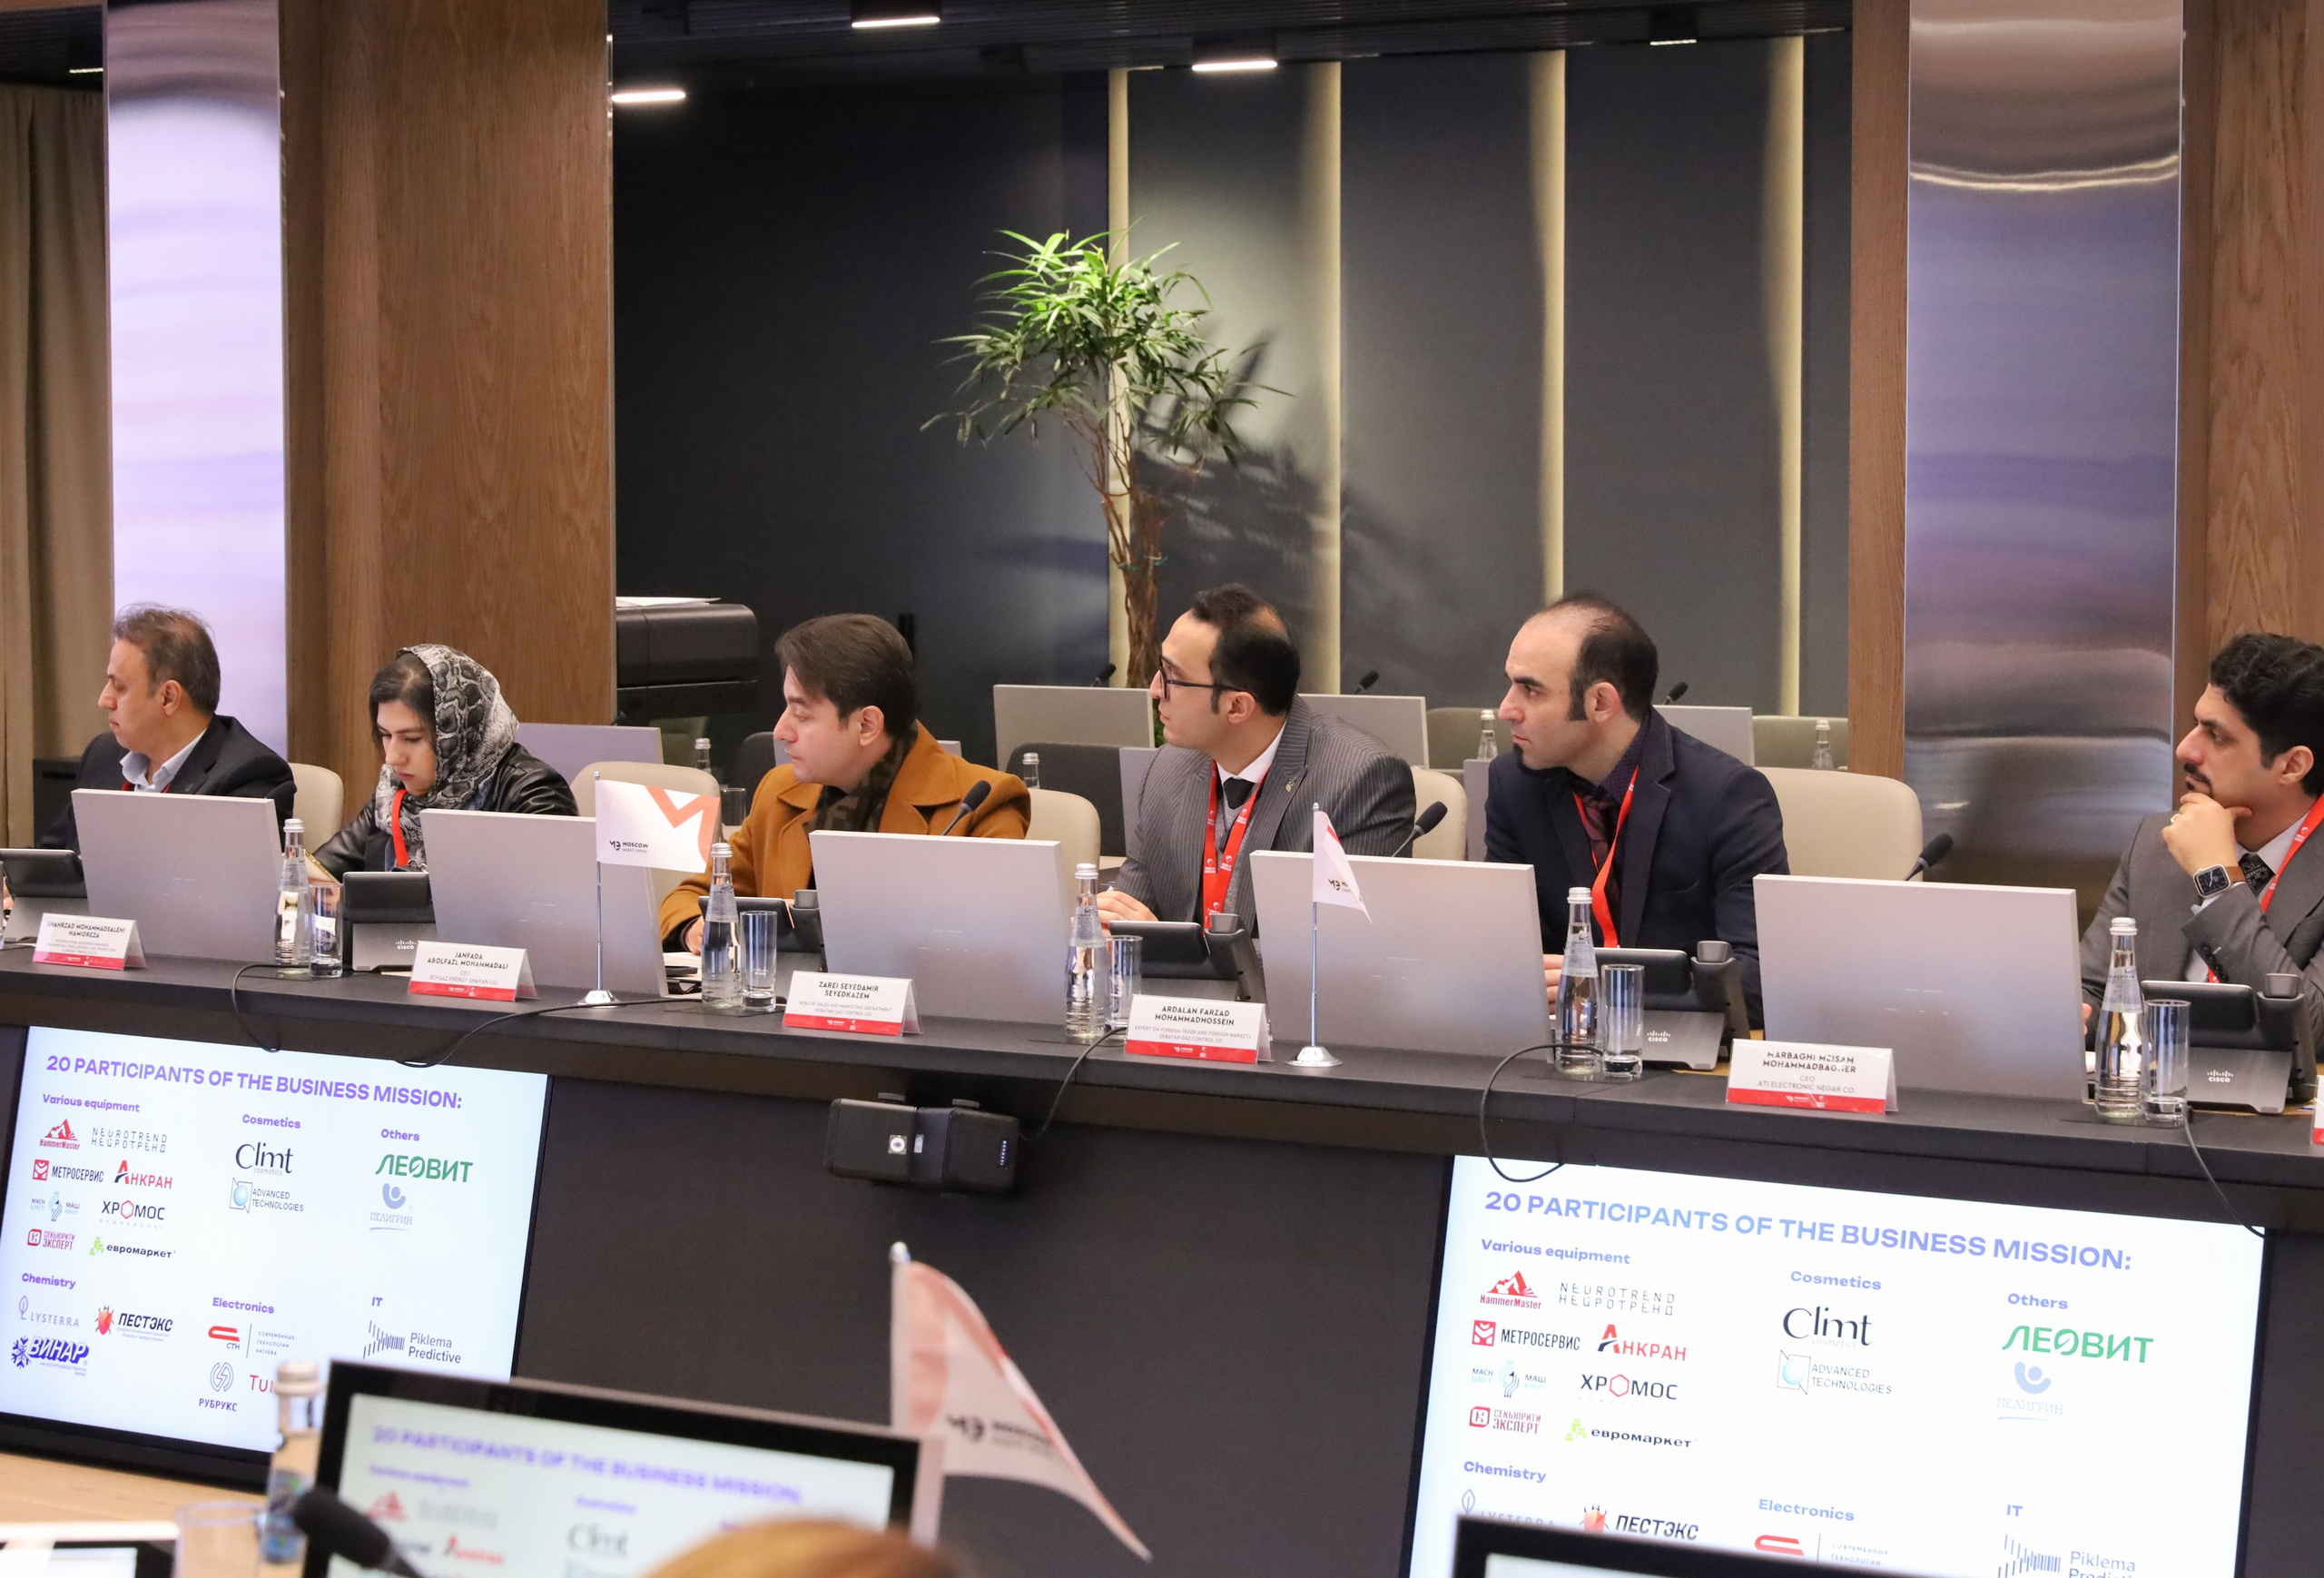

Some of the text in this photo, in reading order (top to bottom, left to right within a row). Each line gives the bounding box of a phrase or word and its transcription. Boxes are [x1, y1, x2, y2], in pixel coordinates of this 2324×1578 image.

[47, 921, 125, 933] SHAHRZAD MOHAMMADSALEHI
[69, 931, 100, 939] HAMIDREZA
[427, 957, 508, 970] ABOLFAZL MOHAMMADALI
[819, 981, 879, 991] ZAREI SEYEDAMIR
[824, 990, 870, 999] SEYEDKAZEM
[1155, 1013, 1235, 1026] MOHAMMADHOSSEIN
[1162, 1006, 1230, 1017] ARDALAN FARZAD
[46, 1055, 462, 1109] 20 PARTICIPANTS OF THE BUSINESS MISSION:
[1770, 1082, 1816, 1090] ELECTRONIC
[1817, 1085, 1841, 1093] NEGAR
[43, 1093, 140, 1113] Various equipment
[241, 1113, 301, 1129] Cosmetics
[93, 1128, 167, 1144] NEUROTREND
[380, 1128, 419, 1142] Others
[40, 1139, 80, 1150] HammerMaster
[51, 1166, 104, 1182] МЕТРОСЕРВИС
[114, 1160, 172, 1189] АНКРАН
[253, 1168, 283, 1176] cosmetics
[376, 1154, 474, 1182] ЛЕОВИТ
[252, 1188, 290, 1200] ADVANCED
[102, 1200, 165, 1220] ХРОМОС
[251, 1198, 304, 1213] TECHNOLOGIES
[369, 1211, 413, 1226] ПЕЛИГРИН
[44, 1230, 75, 1241] СЕКЬЮРИТИ
[1485, 1191, 2132, 1271] 20 PARTICIPANTS OF THE BUSINESS MISSION:
[42, 1238, 74, 1251] ЭКСПЕРТ
[106, 1244, 172, 1258] евромаркет
[1481, 1238, 1630, 1265] Various equipment
[22, 1273, 76, 1289] Chemistry
[1790, 1271, 1882, 1290] Cosmetics
[1560, 1282, 1675, 1305] NEUROTREND
[2007, 1293, 2068, 1309] Others
[212, 1297, 274, 1314] Electronics
[372, 1297, 383, 1307] IT
[1480, 1294, 1541, 1310] HammerMaster
[31, 1312, 80, 1327] LYSTERRA
[118, 1313, 173, 1332] ПЕСТЭКС
[257, 1339, 290, 1347] ТЕХНОЛОГИИ
[258, 1331, 295, 1340] СОВРЕМЕННЫЕ
[410, 1332, 452, 1348] Piklema
[1501, 1328, 1581, 1351] МЕТРОСЕРВИС
[1597, 1324, 1687, 1362] АНКРАН
[27, 1335, 89, 1364] ВИНАР
[2001, 1326, 2154, 1364] ЛЕОВИТ
[409, 1346, 461, 1364] Predictive
[1811, 1364, 1870, 1378] ADVANCED
[1580, 1374, 1678, 1400] ХРОМОС
[1811, 1376, 1893, 1395] TECHNOLOGIES
[199, 1398, 238, 1411] РУБРУКС
[1493, 1408, 1541, 1424] СЕКЬЮРИТИ
[1492, 1418, 1540, 1435] ЭКСПЕРТ
[1590, 1429, 1691, 1447] евромаркет
[1463, 1461, 1547, 1484] Chemistry
[1758, 1498, 1855, 1522] Electronics
[2006, 1504, 2023, 1516] IT
[1616, 1514, 1699, 1541] ПЕСТЭКС
[2070, 1551, 2135, 1573] Piklema
